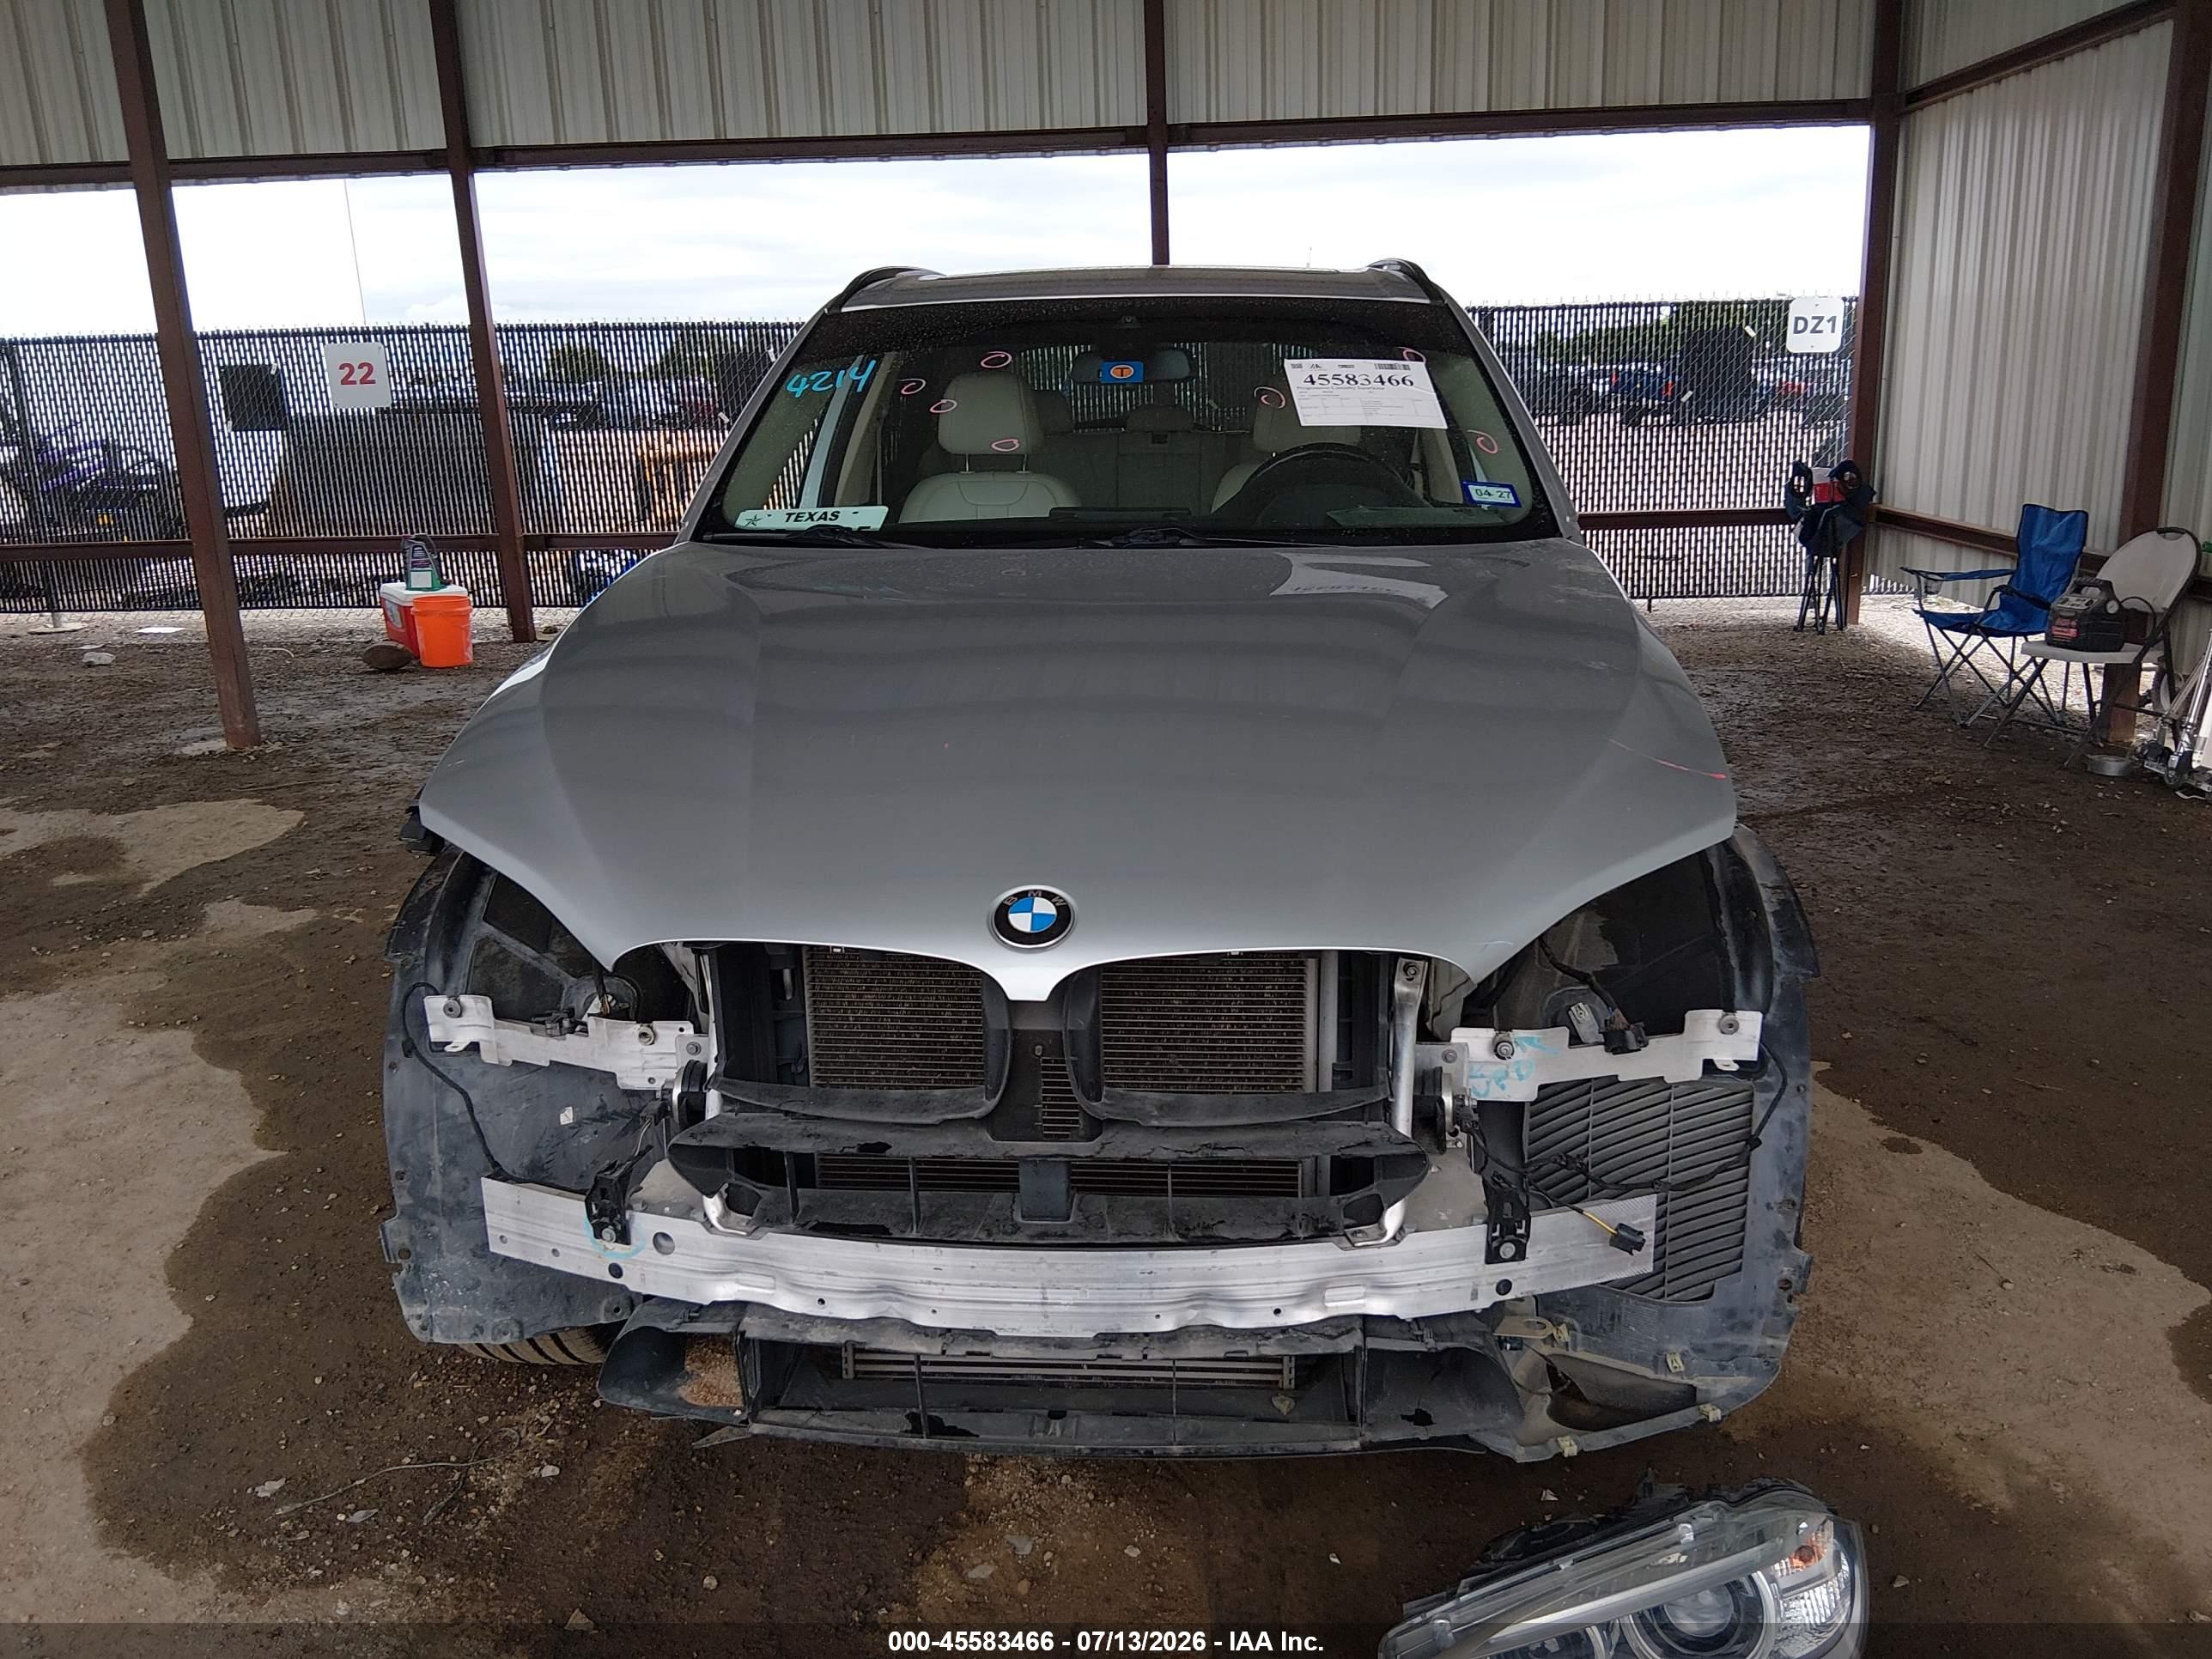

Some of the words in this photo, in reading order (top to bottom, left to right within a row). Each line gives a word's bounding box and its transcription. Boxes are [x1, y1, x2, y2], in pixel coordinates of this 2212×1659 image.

[1792, 315, 1837, 335] DZ1
[338, 362, 376, 386] 22
[787, 360, 876, 398] 4214
[1304, 374, 1414, 387] 45583466
[1475, 489, 1493, 497] 04
[1496, 490, 1511, 499] 27
[784, 511, 841, 523] TEXAS
[1003, 890, 1066, 907] BMW
